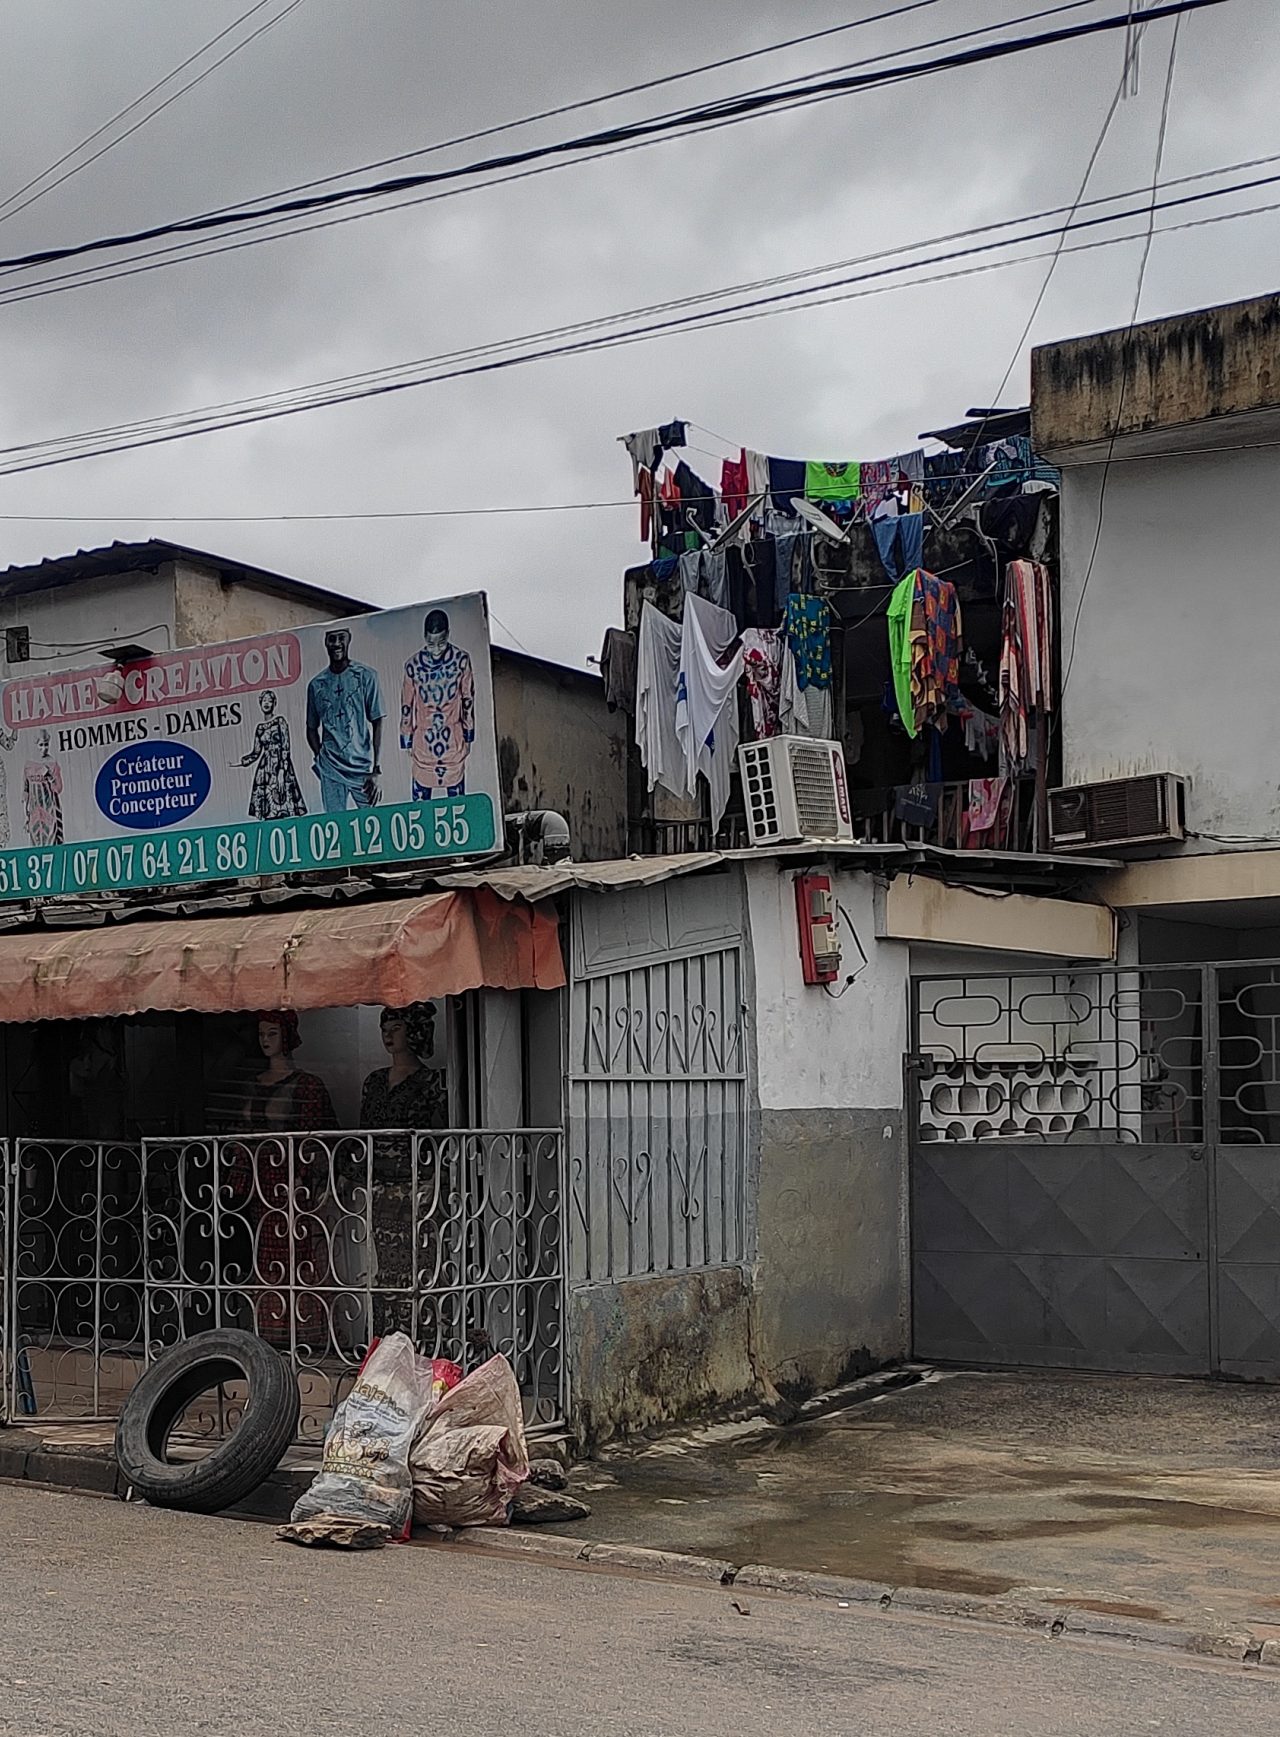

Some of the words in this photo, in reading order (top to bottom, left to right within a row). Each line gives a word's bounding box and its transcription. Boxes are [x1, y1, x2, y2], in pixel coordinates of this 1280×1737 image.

[124, 644, 292, 704] CREATION
[58, 718, 148, 752] HOMMES
[165, 703, 243, 736] DAMES
[115, 755, 184, 776] Créateur
[111, 773, 193, 797] Promoteur
[109, 792, 197, 816] Concepteur
[28, 854, 54, 890] 37
[73, 849, 99, 886] 07
[106, 844, 134, 882] 07
[142, 840, 171, 879] 64
[178, 836, 209, 874] 21
[216, 831, 248, 871] 86
[270, 825, 302, 865] 01
[309, 820, 342, 861] 02
[349, 815, 383, 856] 12
[391, 809, 425, 852] 05
[434, 804, 469, 847] 55
